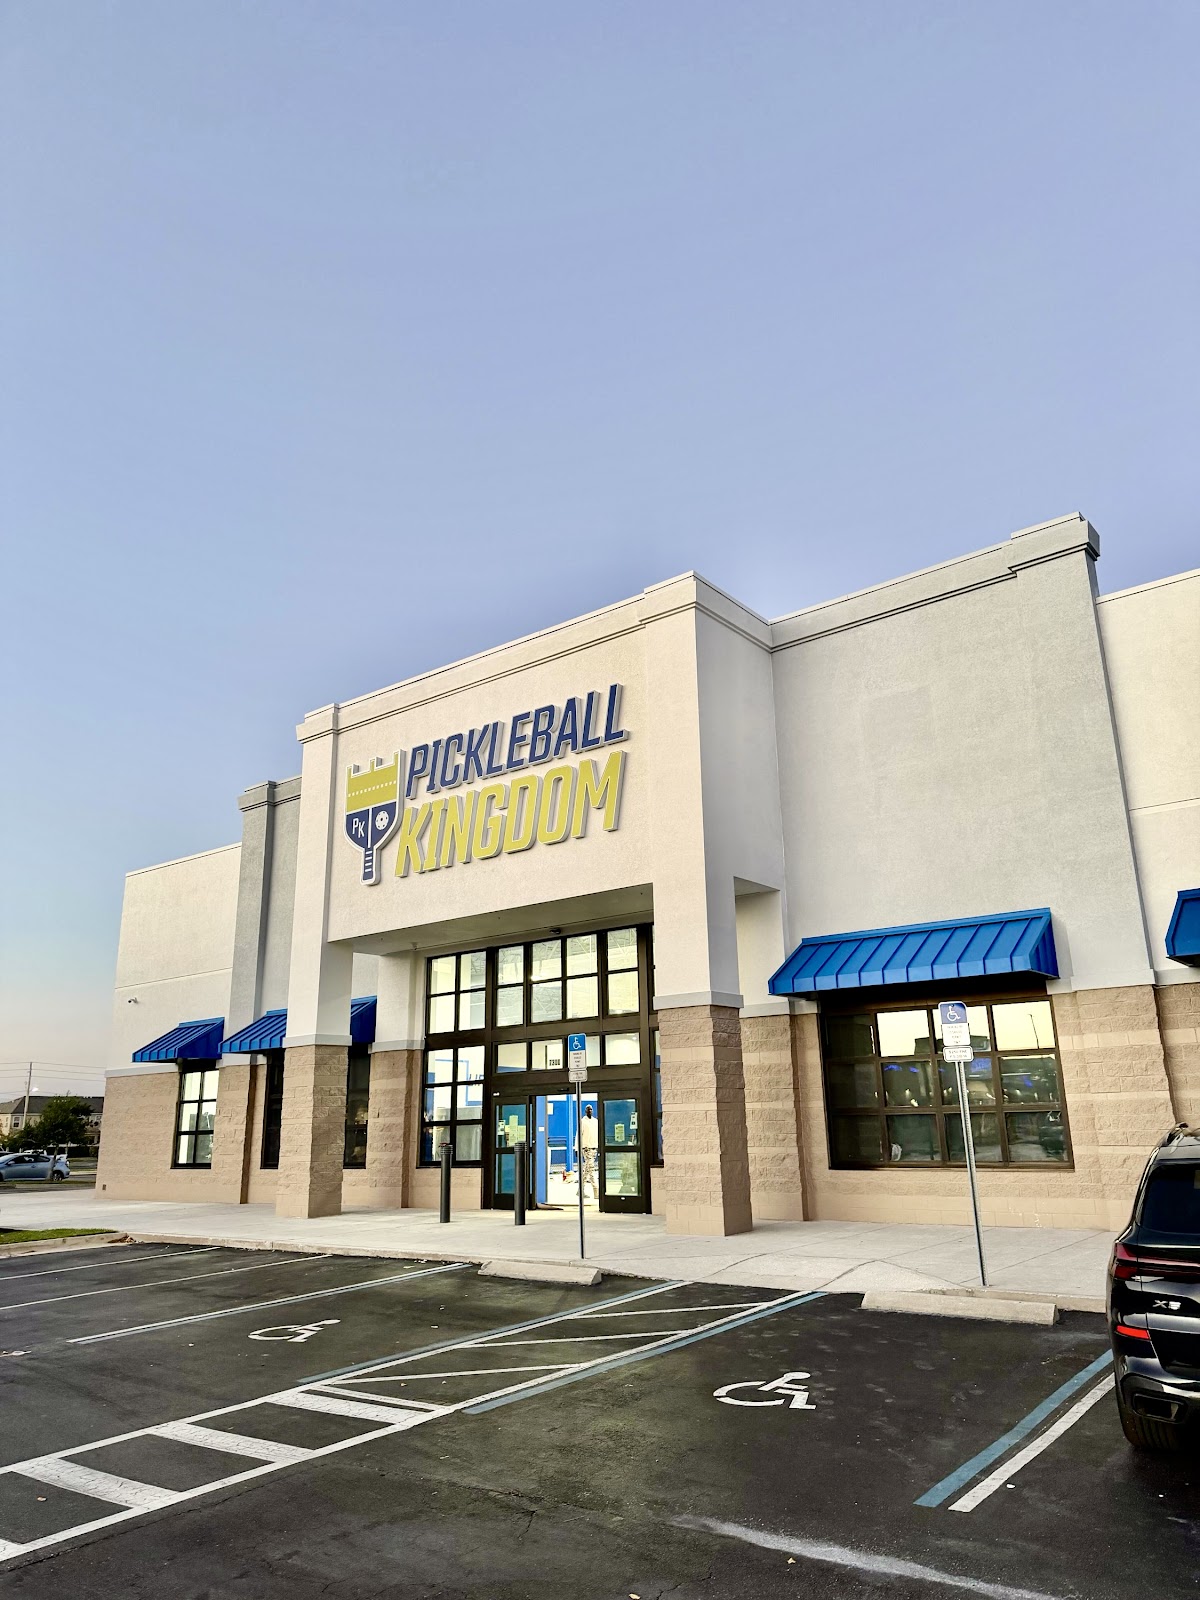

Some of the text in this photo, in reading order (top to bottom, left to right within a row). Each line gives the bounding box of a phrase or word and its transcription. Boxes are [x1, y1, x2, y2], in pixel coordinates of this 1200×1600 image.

[405, 683, 630, 800] PICKLEBALL
[352, 817, 366, 839] PK
[395, 750, 627, 878] KINGDOM
